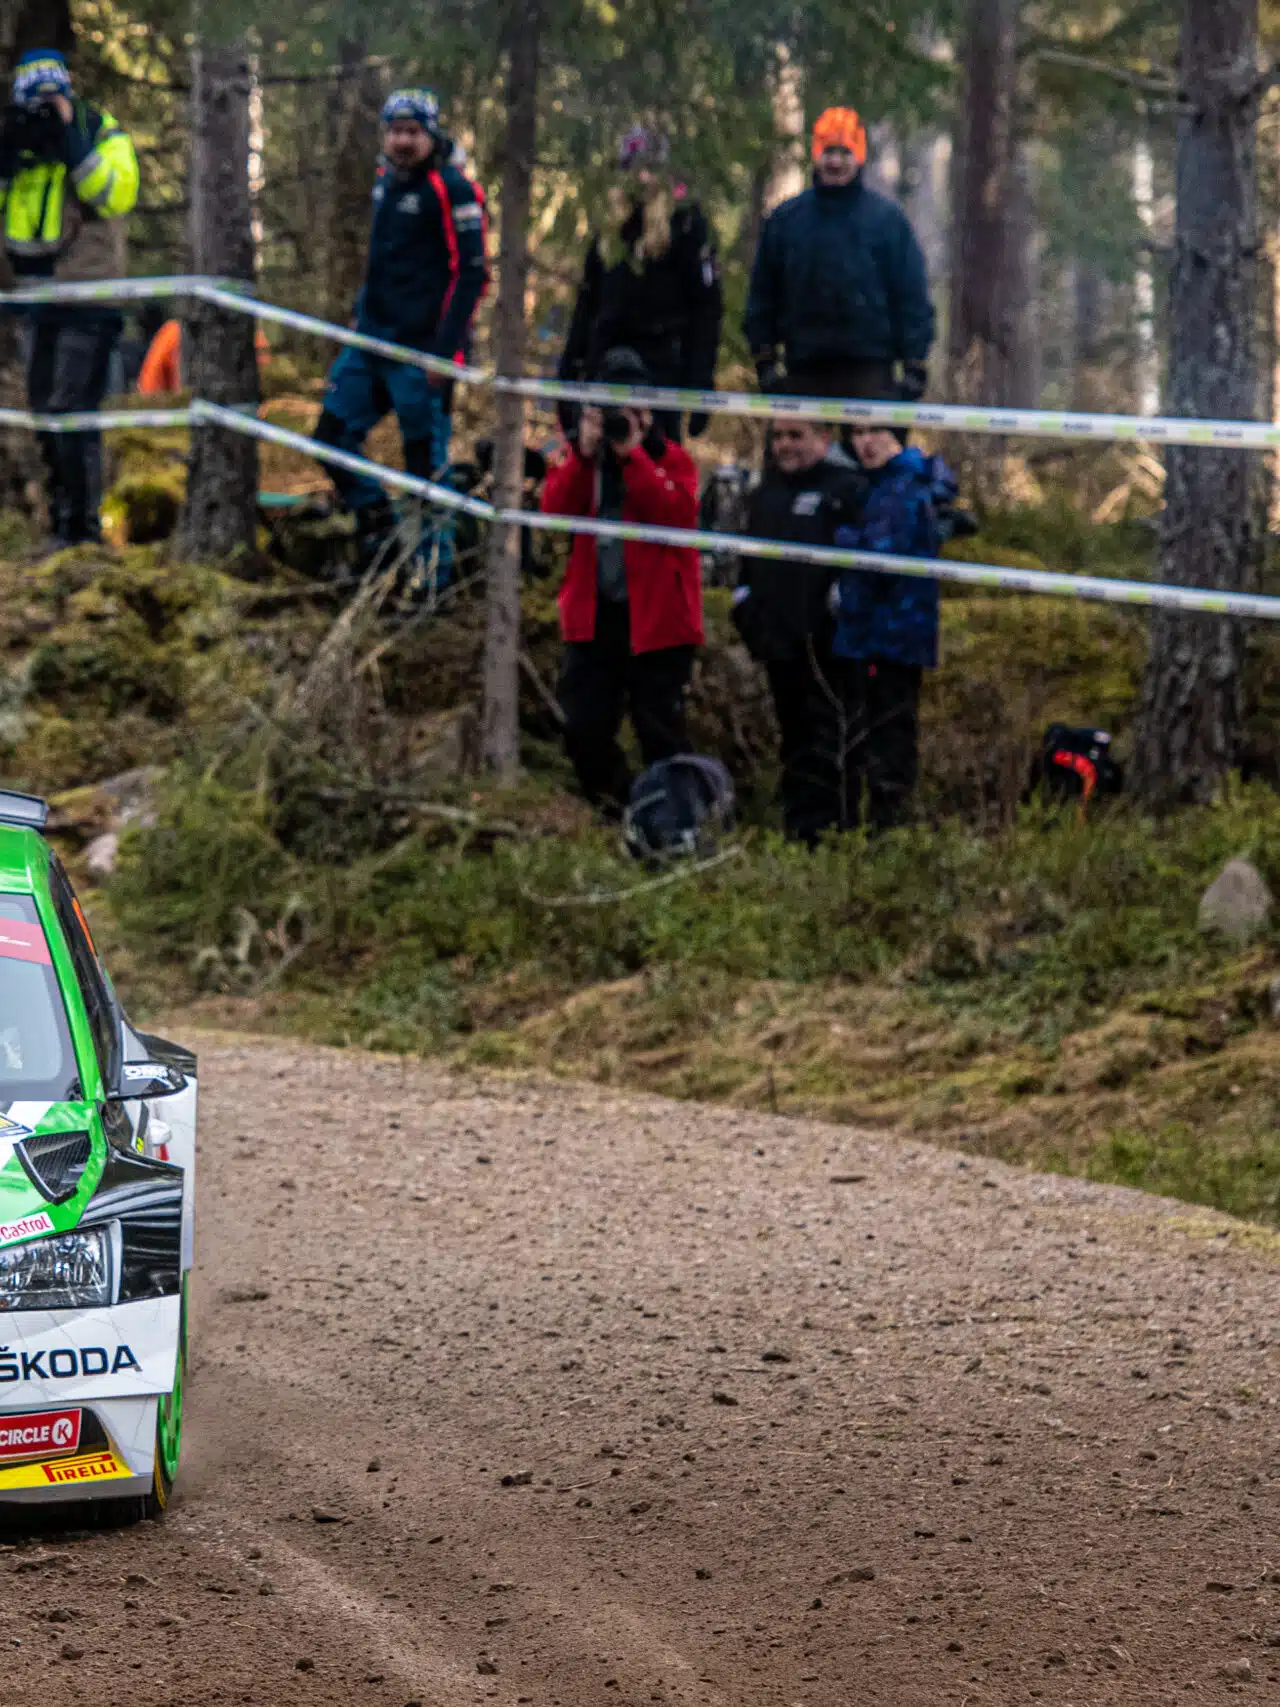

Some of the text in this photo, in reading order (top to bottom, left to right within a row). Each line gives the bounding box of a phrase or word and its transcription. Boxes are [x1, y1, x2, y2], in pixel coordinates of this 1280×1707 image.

[0, 1215, 50, 1241] Castrol
[51, 1417, 73, 1445] K
[40, 1453, 118, 1482] PIRELLI
